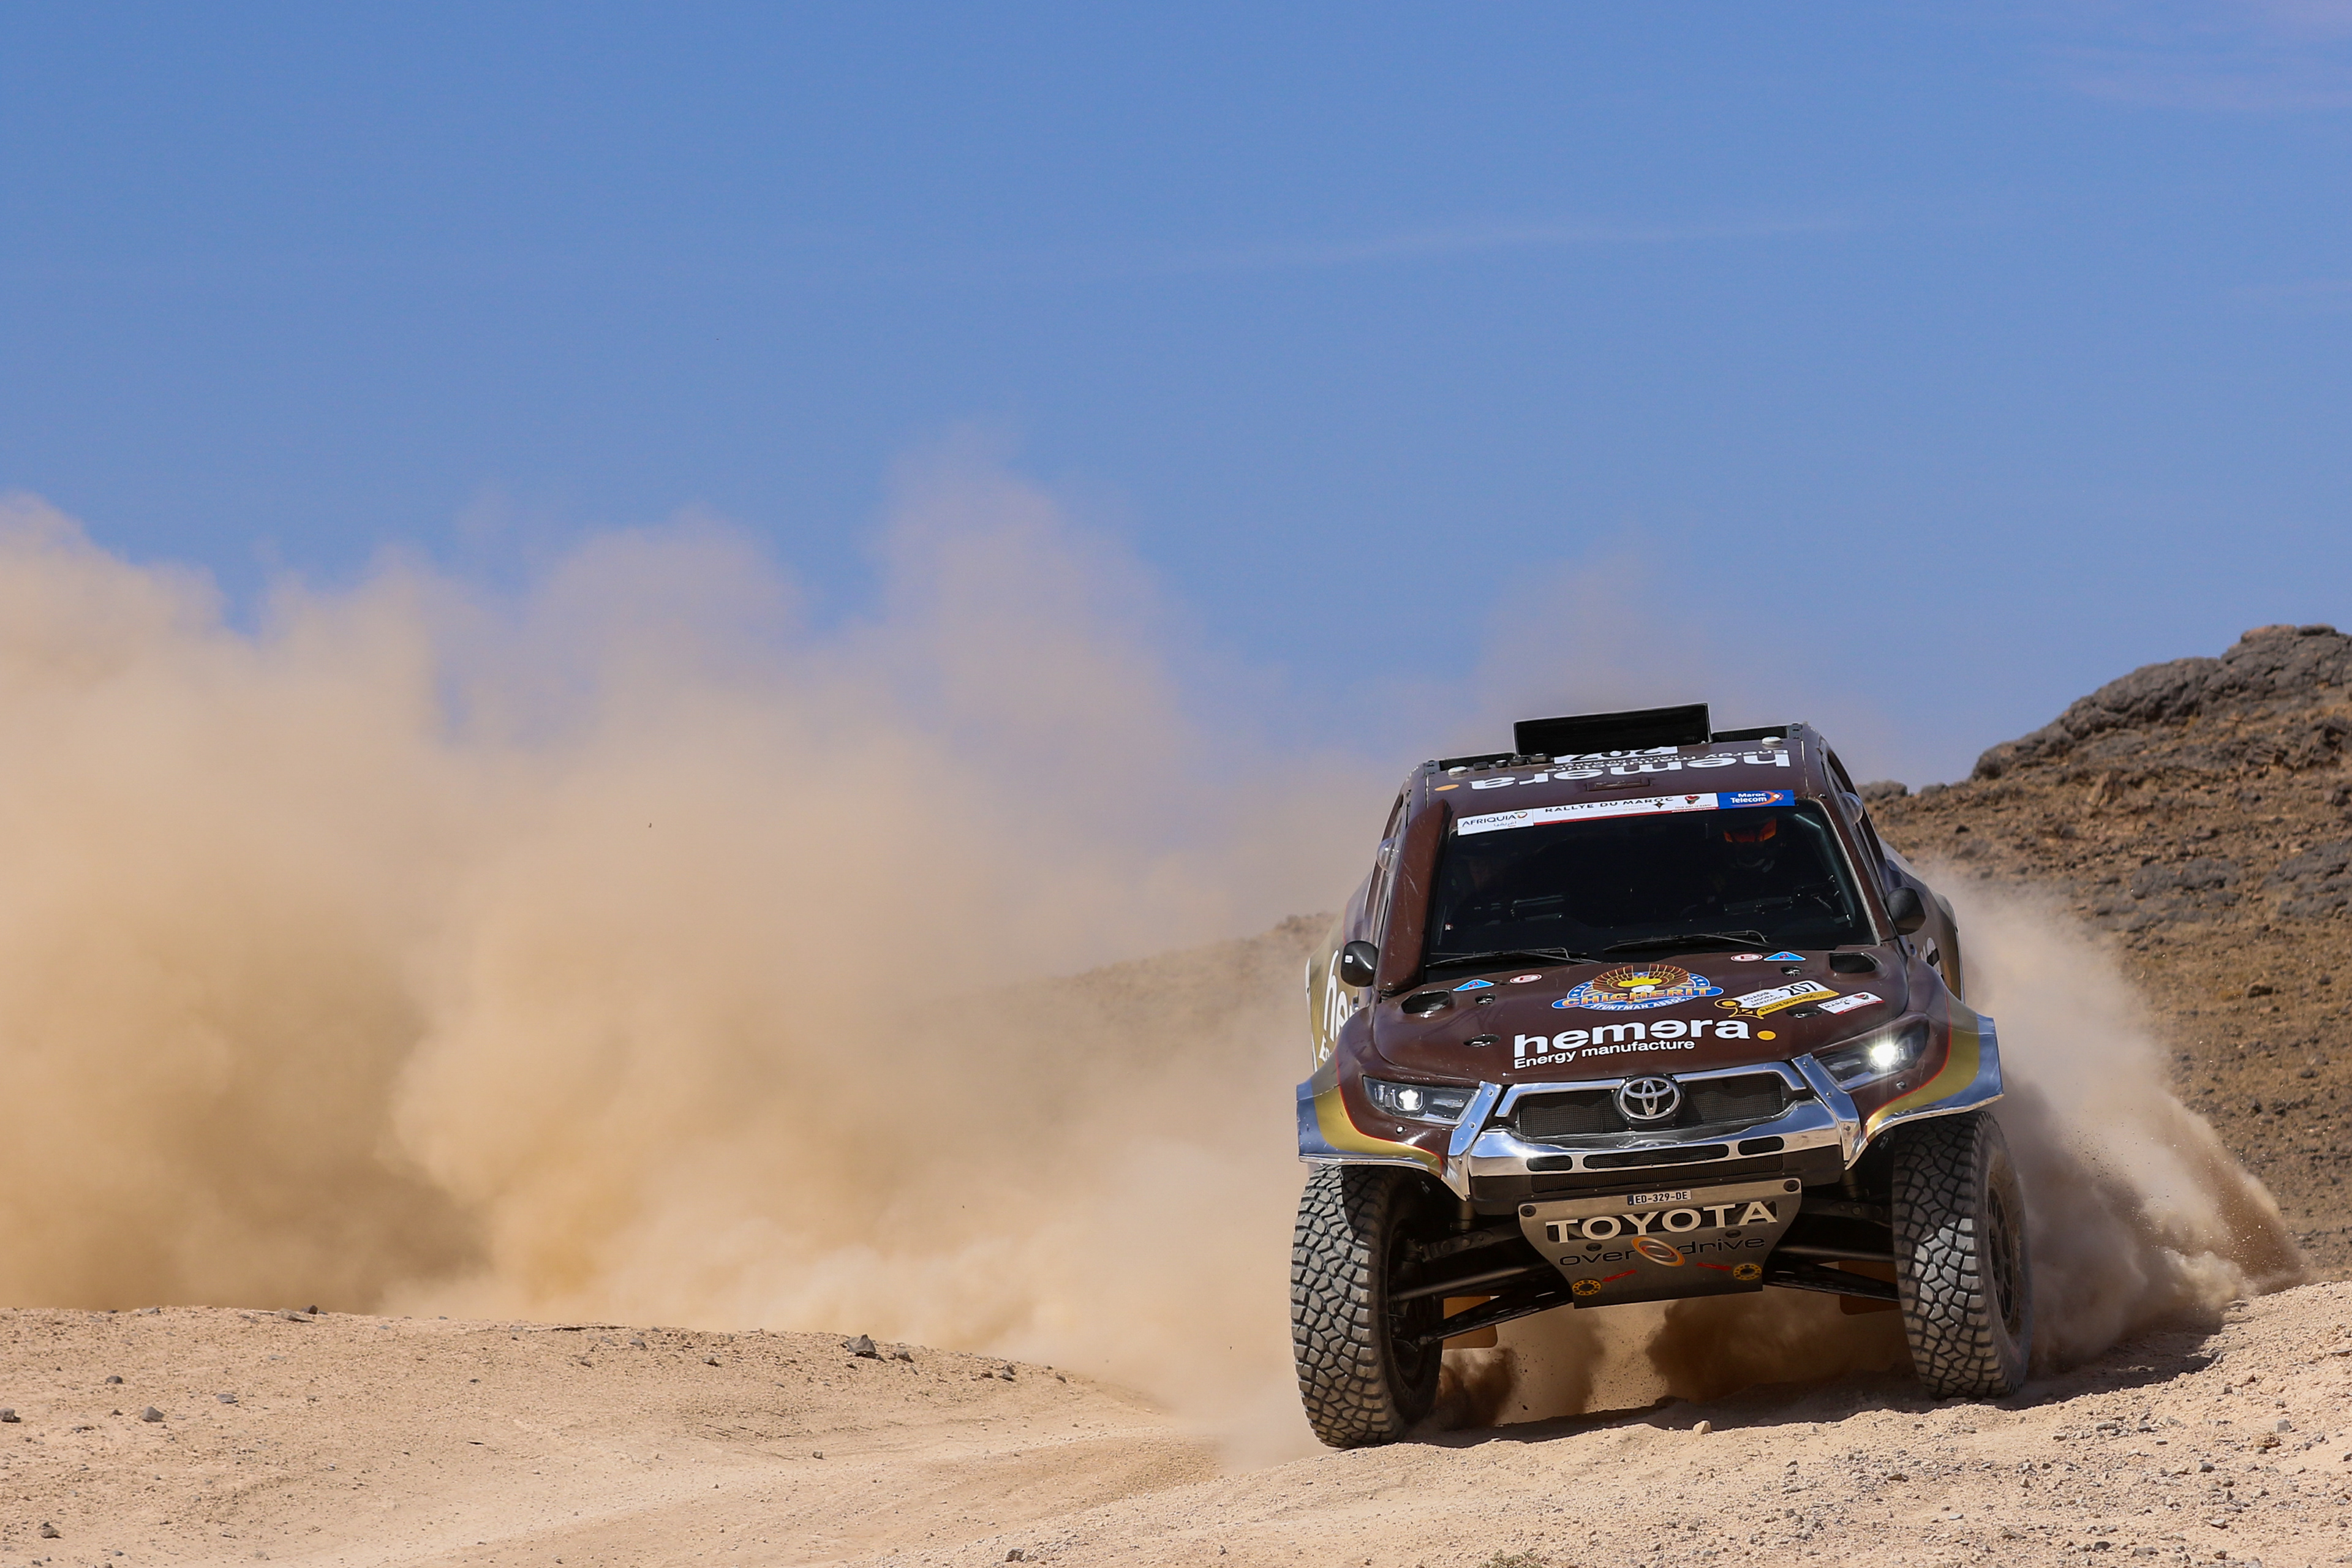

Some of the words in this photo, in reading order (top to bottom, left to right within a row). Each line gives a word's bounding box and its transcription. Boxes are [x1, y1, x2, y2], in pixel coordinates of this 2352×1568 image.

[1469, 753, 1790, 790] hemera
[1545, 804, 1594, 813] RALLYE
[1623, 797, 1674, 805] MAROC
[1462, 815, 1517, 827] AFRIQUIA
[1562, 987, 1712, 1007] CHICHERIT
[1778, 982, 1819, 996] 207
[1760, 1001, 1783, 1012] RALLYE
[1514, 1019, 1751, 1058] hemera
[1513, 1050, 1577, 1069] Energy
[1581, 1039, 1695, 1058] manufacture
[1635, 1191, 1687, 1204] ED-329-DE
[1545, 1201, 1777, 1243] TOYOTA
[1559, 1250, 1638, 1266] over
[1676, 1237, 1765, 1255] drive
